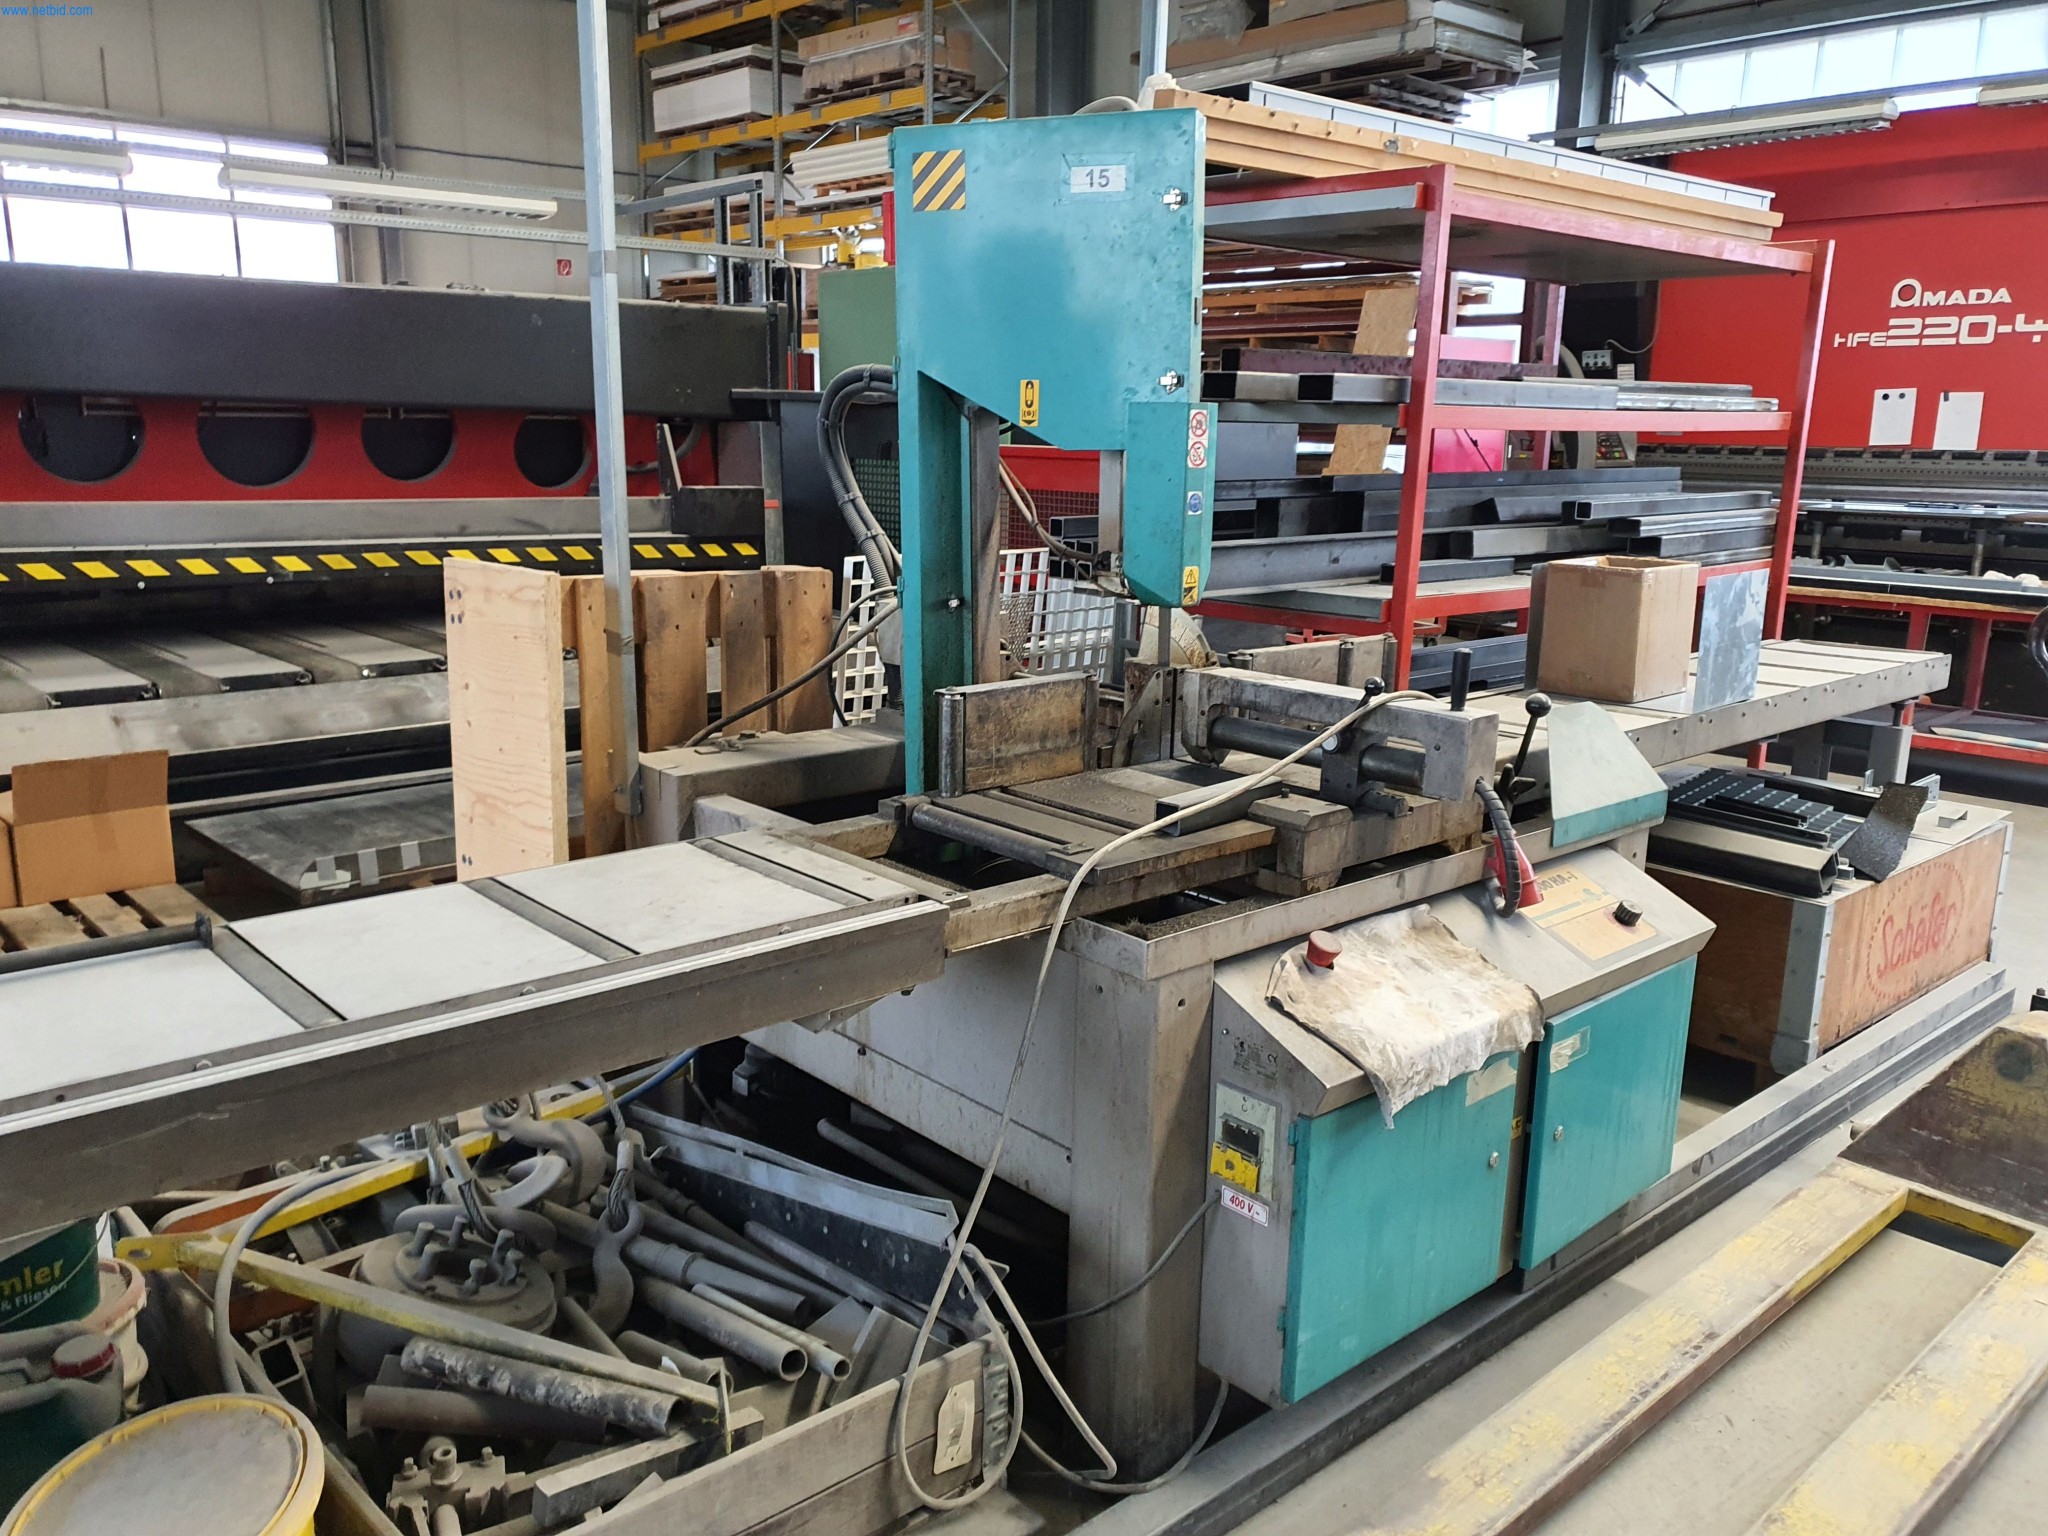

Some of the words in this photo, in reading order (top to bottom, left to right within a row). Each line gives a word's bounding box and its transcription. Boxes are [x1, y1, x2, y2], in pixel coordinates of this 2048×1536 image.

[1085, 168, 1110, 188] 15
[1890, 278, 2012, 308] AMADA
[1876, 891, 1957, 979] Schäfer
[1229, 1194, 1246, 1210] 400
[1247, 1202, 1254, 1214] V
